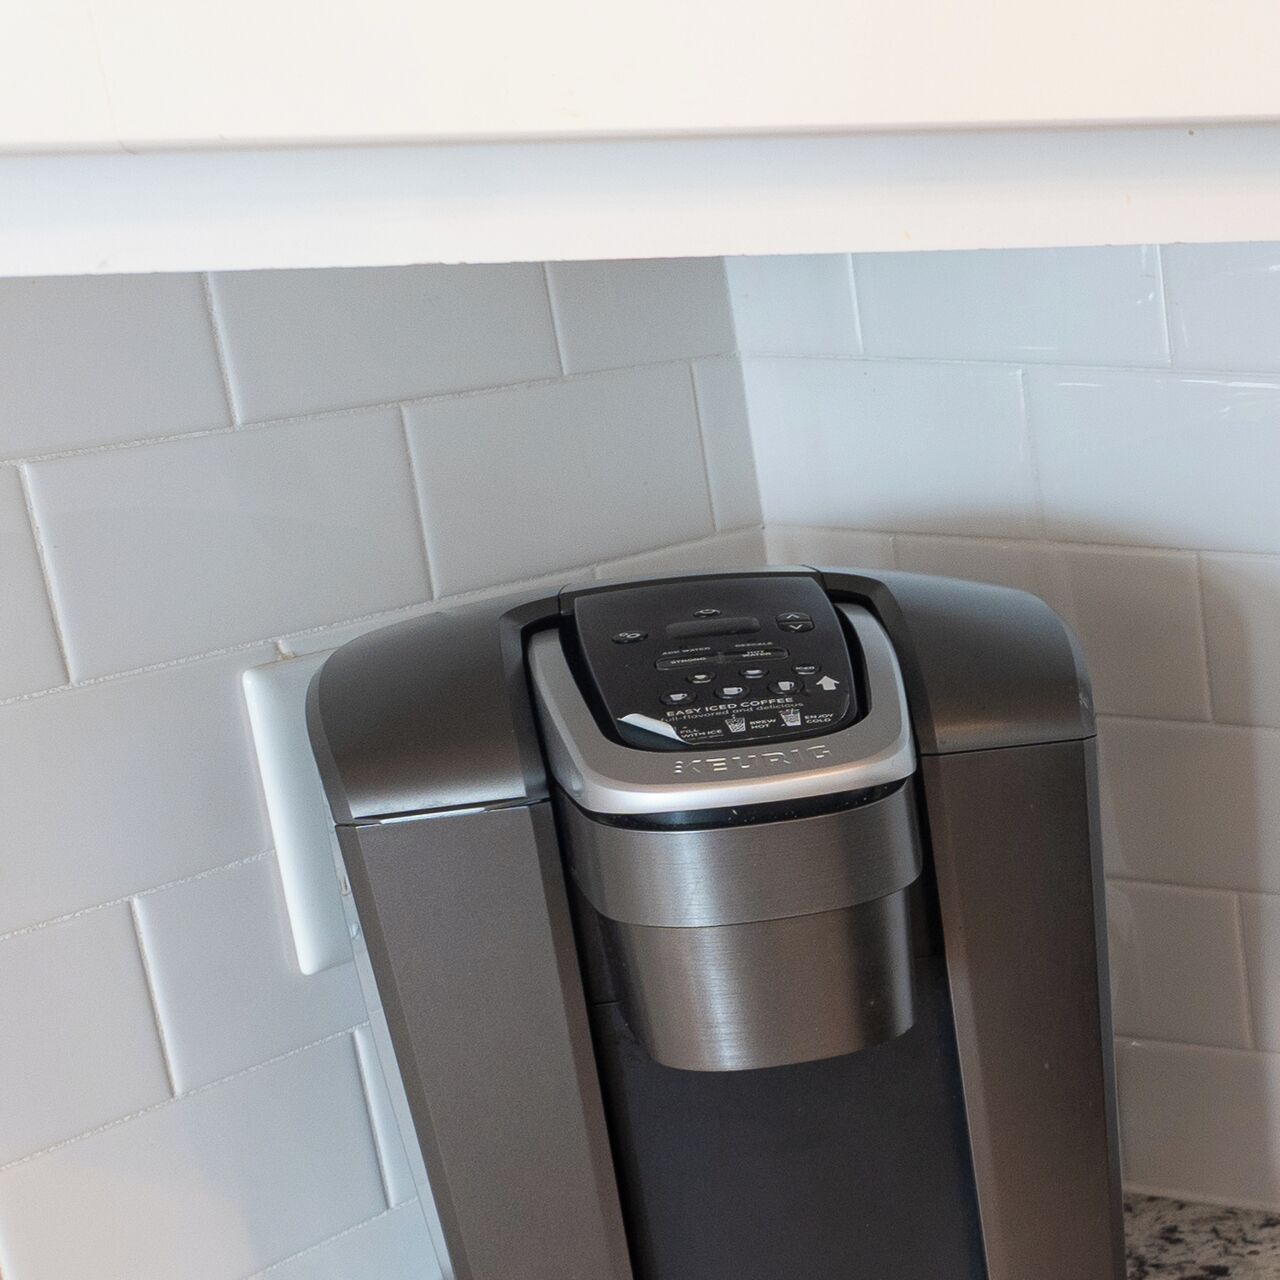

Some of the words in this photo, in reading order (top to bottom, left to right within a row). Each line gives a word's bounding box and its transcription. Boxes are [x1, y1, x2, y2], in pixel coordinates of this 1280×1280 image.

[666, 707, 702, 718] EASY
[704, 702, 738, 712] ICED
[740, 697, 794, 709] COFFEE
[732, 706, 754, 715] and
[756, 702, 804, 712] delicious
[750, 718, 777, 726] BREW
[806, 717, 832, 725] COLD
[681, 730, 706, 739] WITH
[707, 728, 723, 736] ICE
[674, 745, 833, 774] KEURIG
